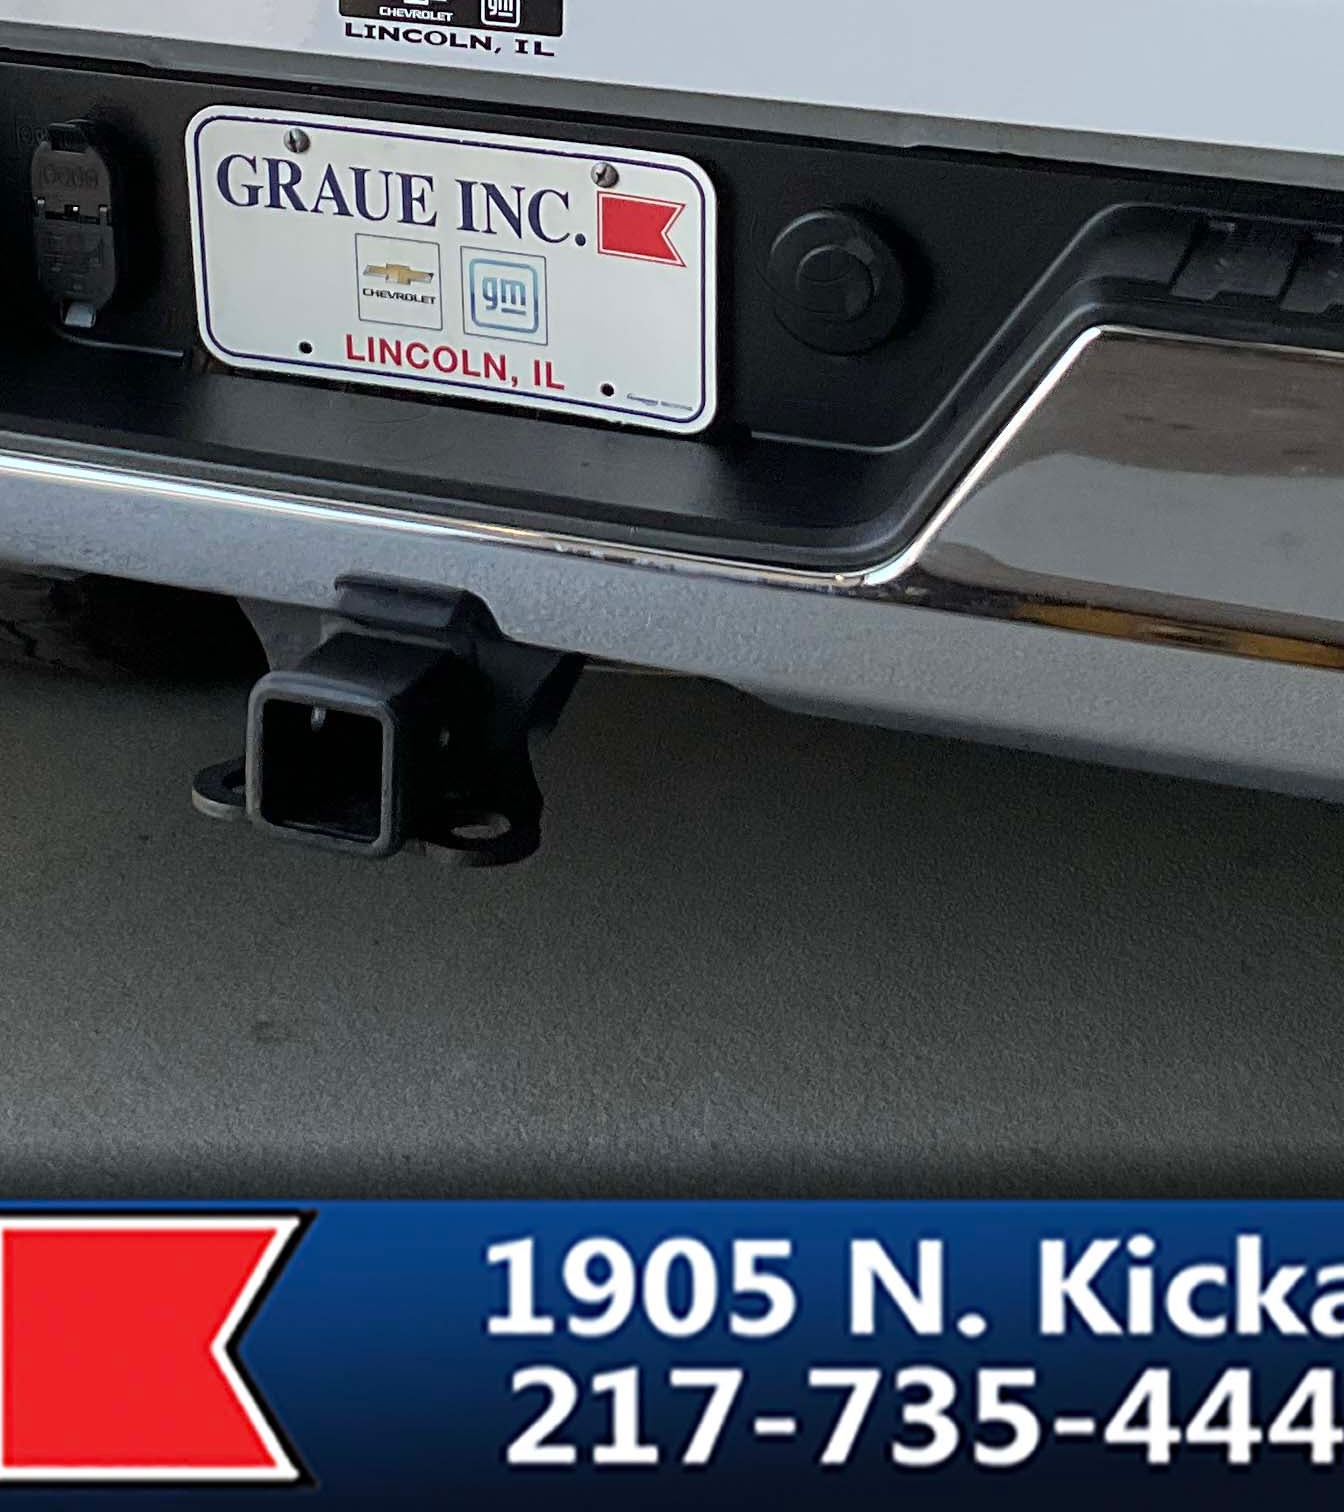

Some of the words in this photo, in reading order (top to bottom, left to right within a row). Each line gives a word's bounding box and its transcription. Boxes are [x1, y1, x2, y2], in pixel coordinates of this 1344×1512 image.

[378, 6, 454, 23] CHEVROLET
[344, 22, 502, 55] LINCOLN,
[514, 38, 556, 57] IL
[216, 153, 439, 228] GRAUE
[455, 178, 587, 247] INC.
[361, 287, 438, 305] CHEVROLET
[481, 275, 527, 316] gm
[345, 333, 519, 388] LINCOLN,
[533, 358, 566, 390] IL
